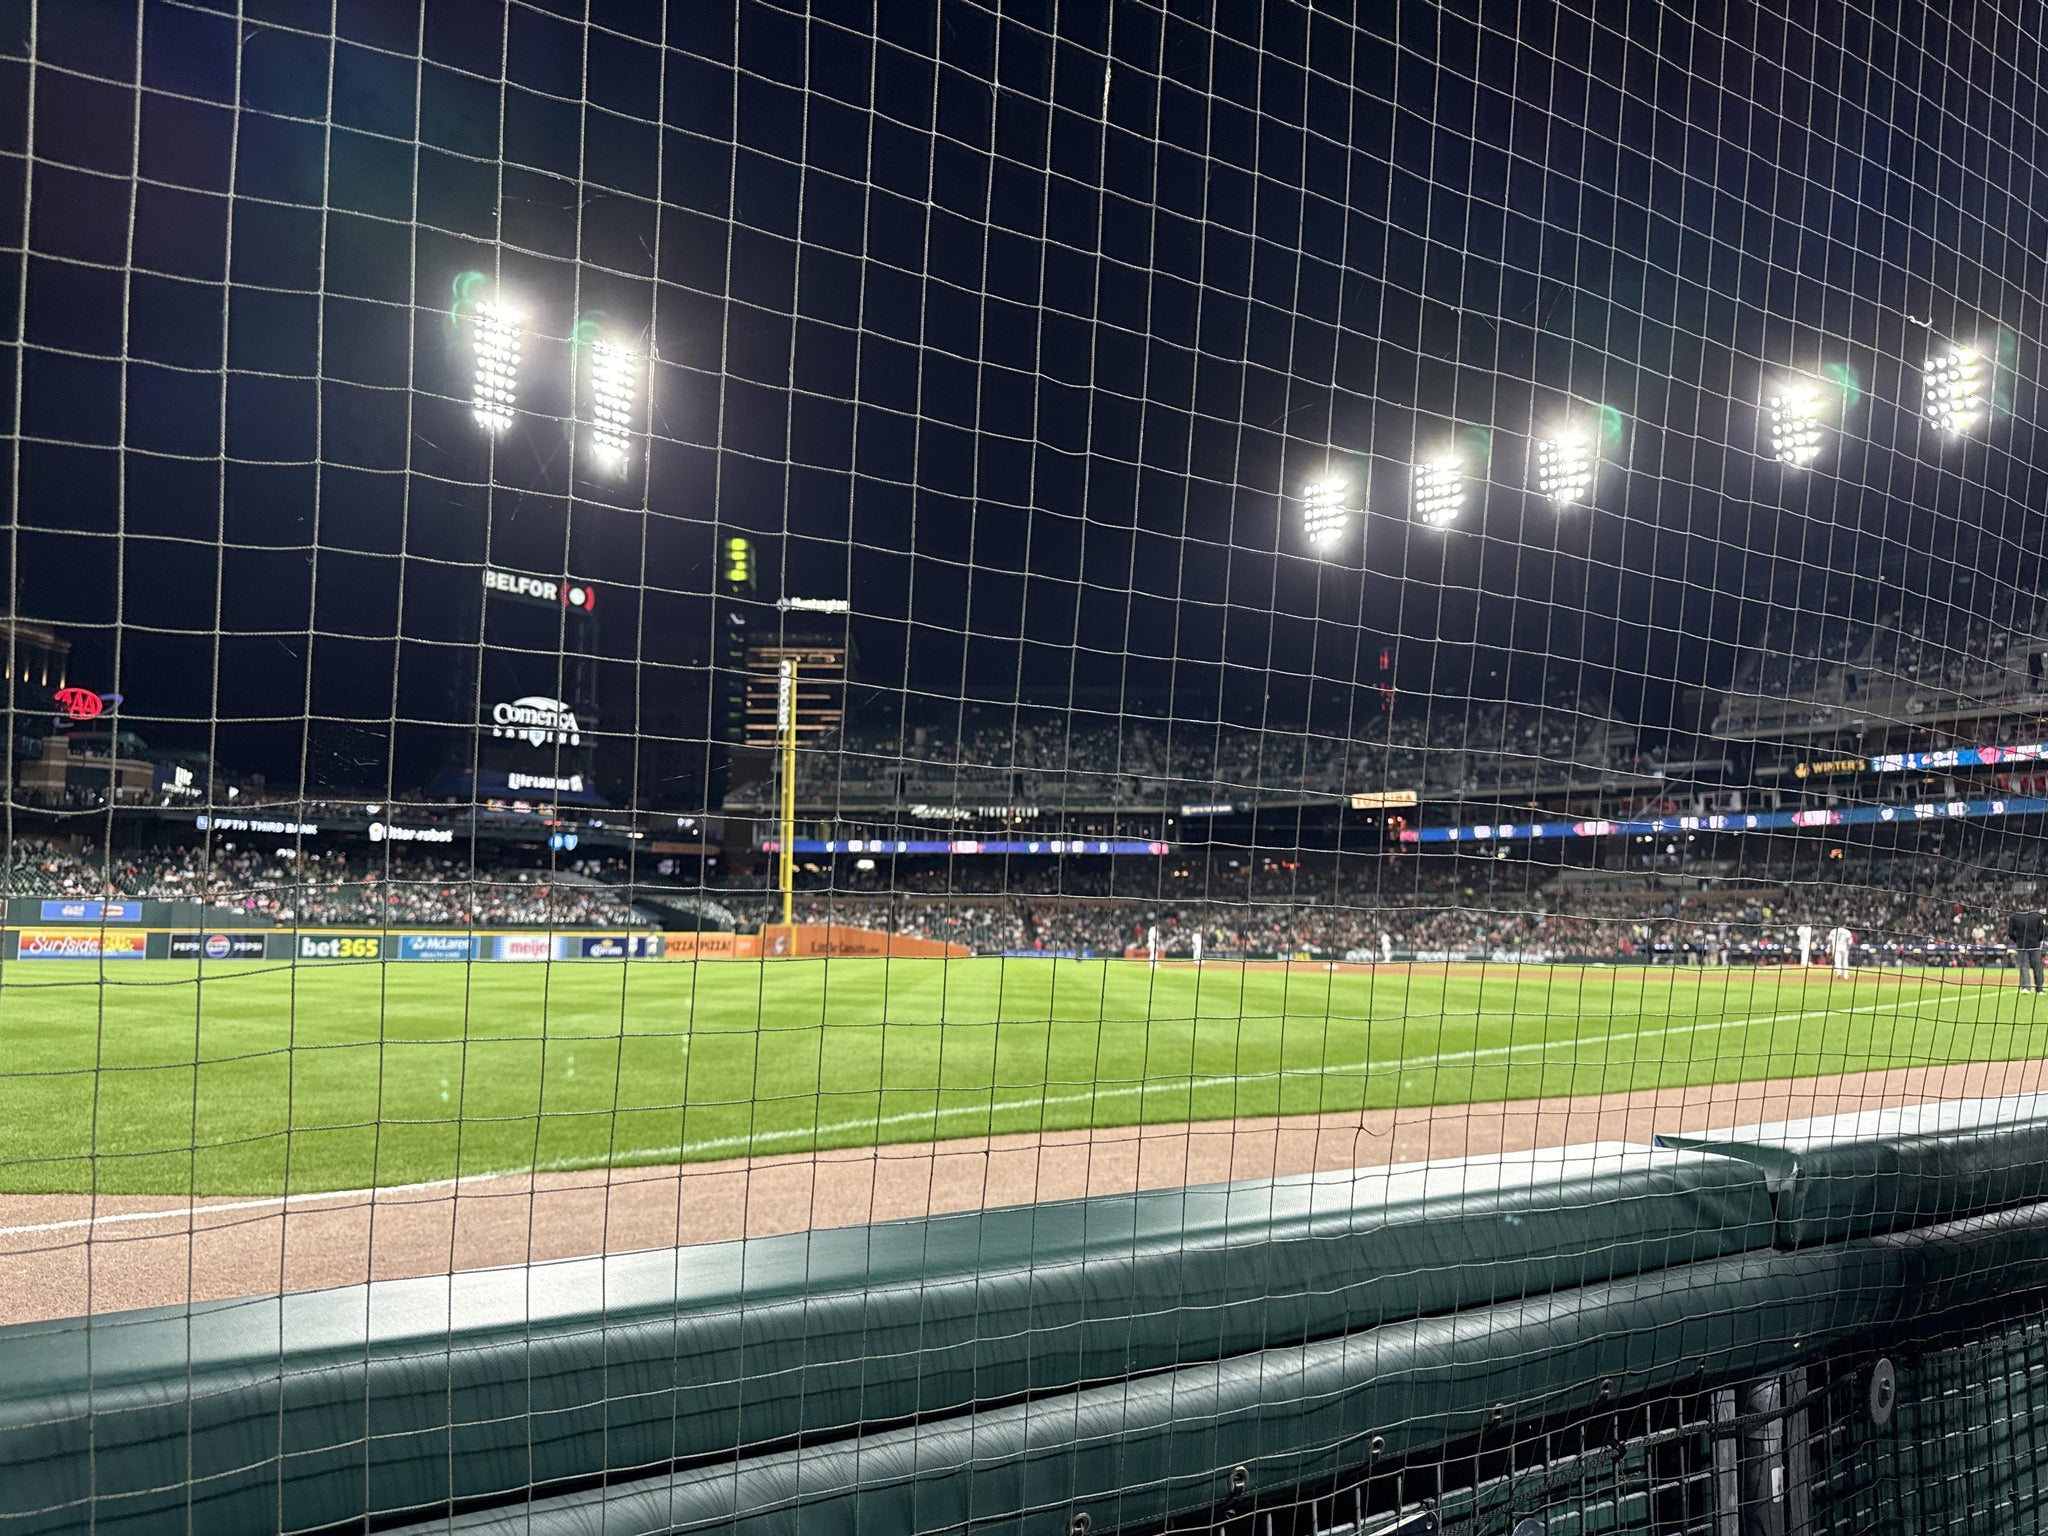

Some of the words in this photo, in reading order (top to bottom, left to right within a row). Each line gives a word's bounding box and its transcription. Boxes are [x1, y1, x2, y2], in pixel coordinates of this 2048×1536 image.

[483, 570, 558, 600] BELFOR
[214, 818, 248, 831] FIFTH
[250, 820, 285, 833] THIRD
[285, 823, 318, 836] BANK
[30, 934, 99, 955] Surfside
[301, 937, 379, 958] bet365
[427, 936, 472, 951] McLaren
